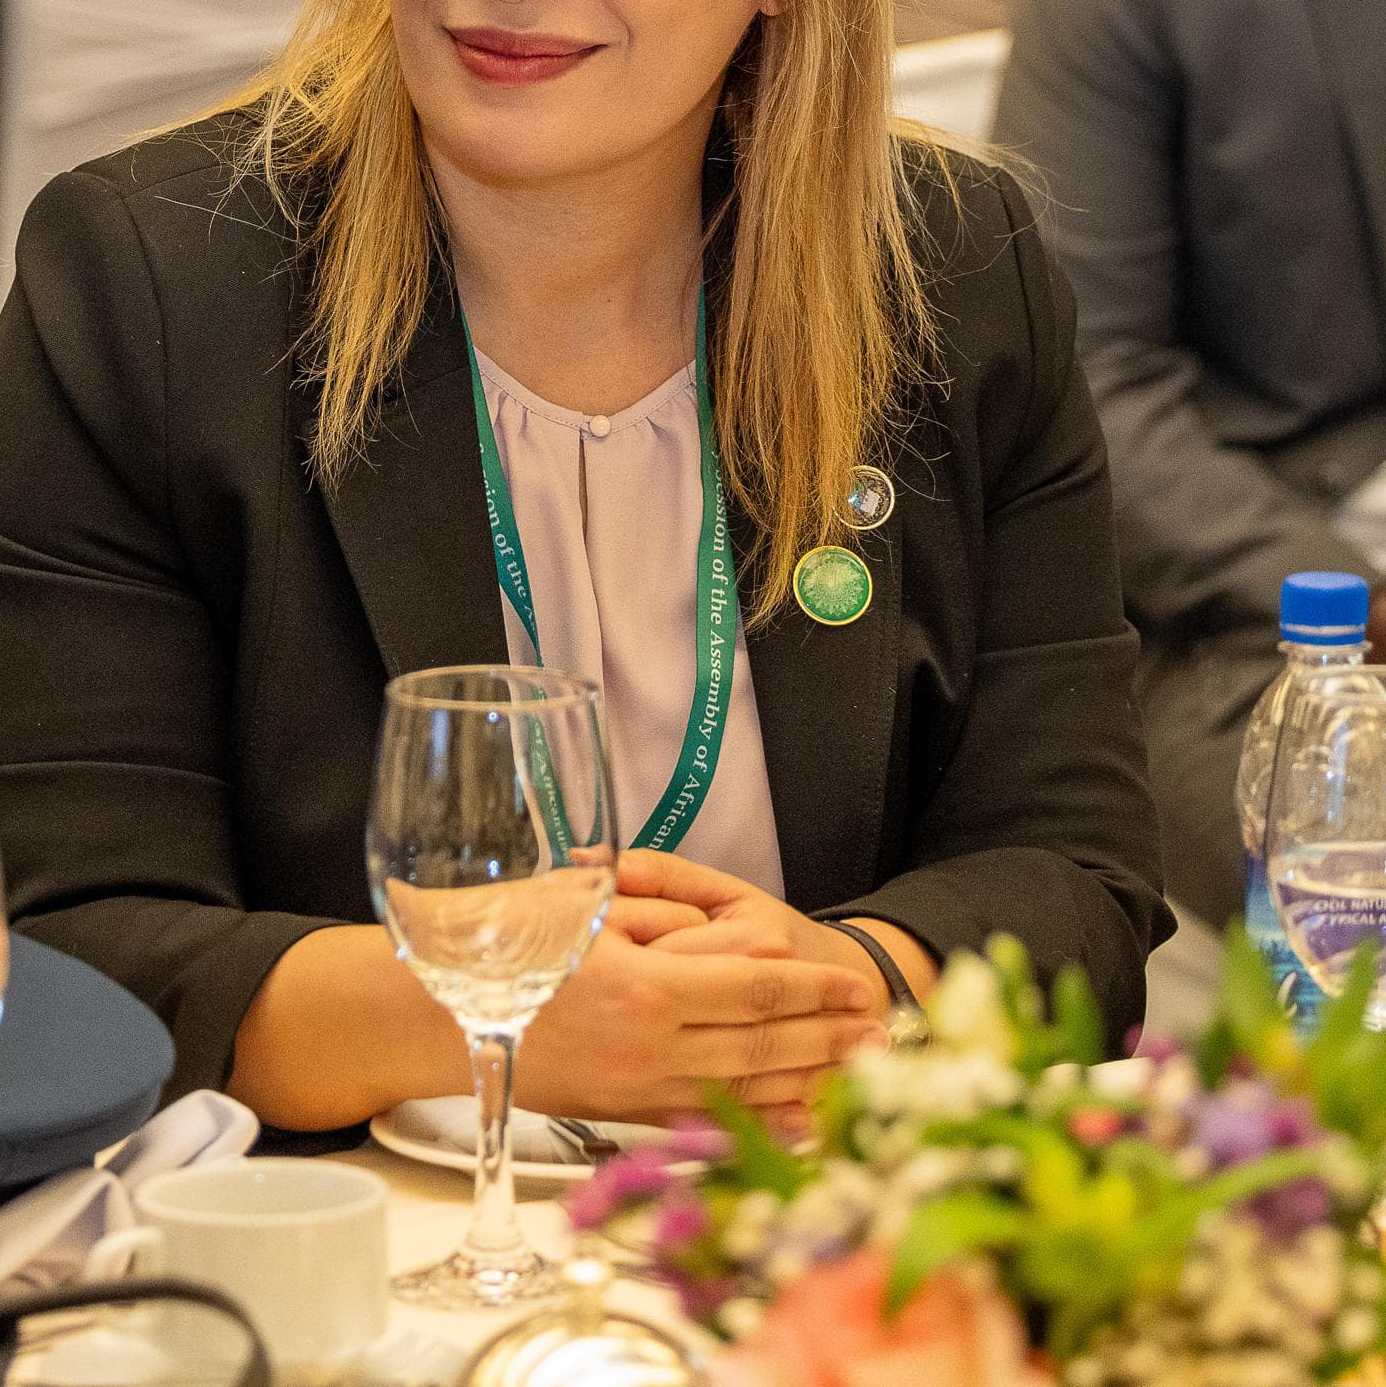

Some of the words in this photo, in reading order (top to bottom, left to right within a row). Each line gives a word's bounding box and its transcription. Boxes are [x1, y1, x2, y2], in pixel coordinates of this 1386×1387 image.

[494, 533, 516, 558] of
[506, 559, 528, 598] the
[711, 558, 729, 586] of
[710, 588, 728, 625] the
[696, 630, 726, 741] Assembly
[692, 746, 709, 773] of
[648, 773, 701, 850] African
